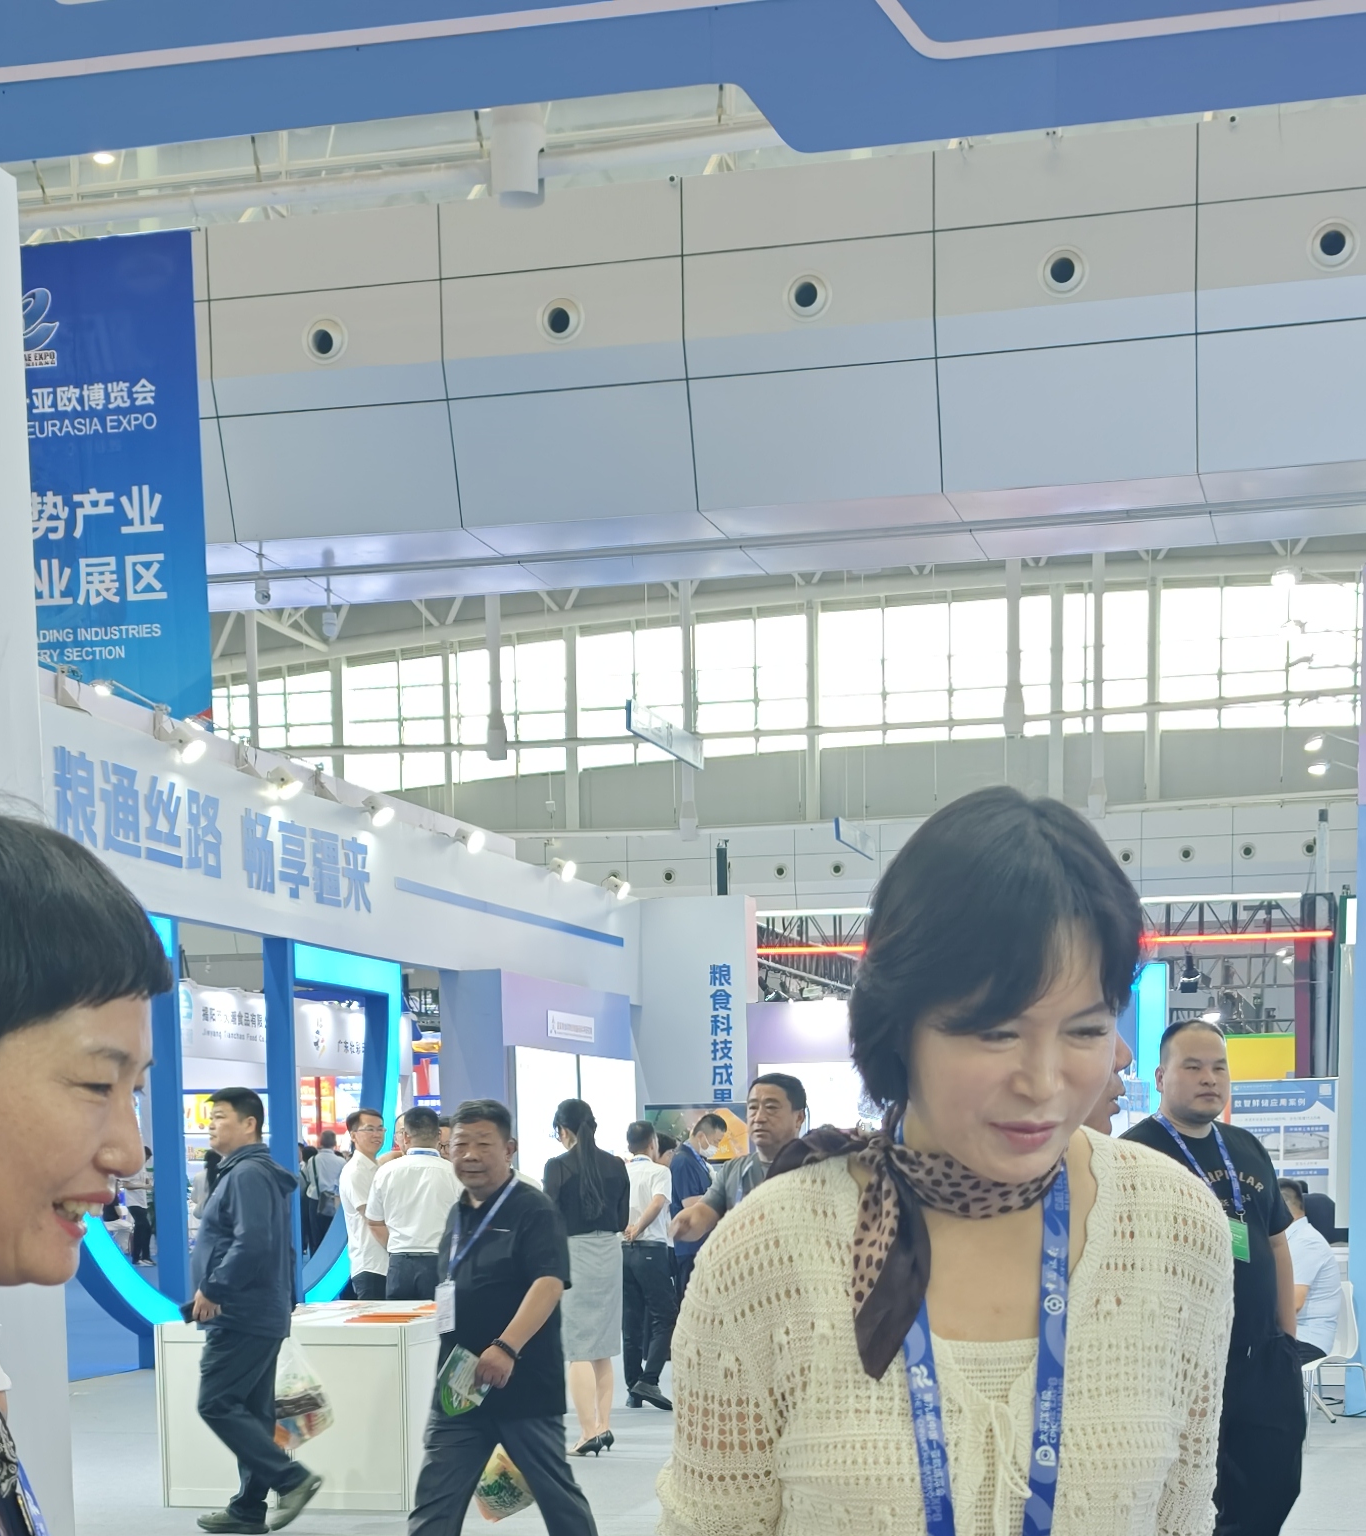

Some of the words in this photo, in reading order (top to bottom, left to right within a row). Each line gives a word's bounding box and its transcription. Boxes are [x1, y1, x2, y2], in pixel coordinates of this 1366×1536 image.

[107, 412, 157, 434] EXPO
[31, 485, 165, 540] 势产业
[35, 553, 168, 605] 业展区
[36, 627, 75, 644] DING
[77, 623, 162, 641] INDUSTRIES
[63, 645, 126, 661] SECTION
[52, 744, 225, 880] 粮通丝路
[240, 806, 373, 914] 畅享疆来
[708, 962, 734, 1103] 粮食科技成果
